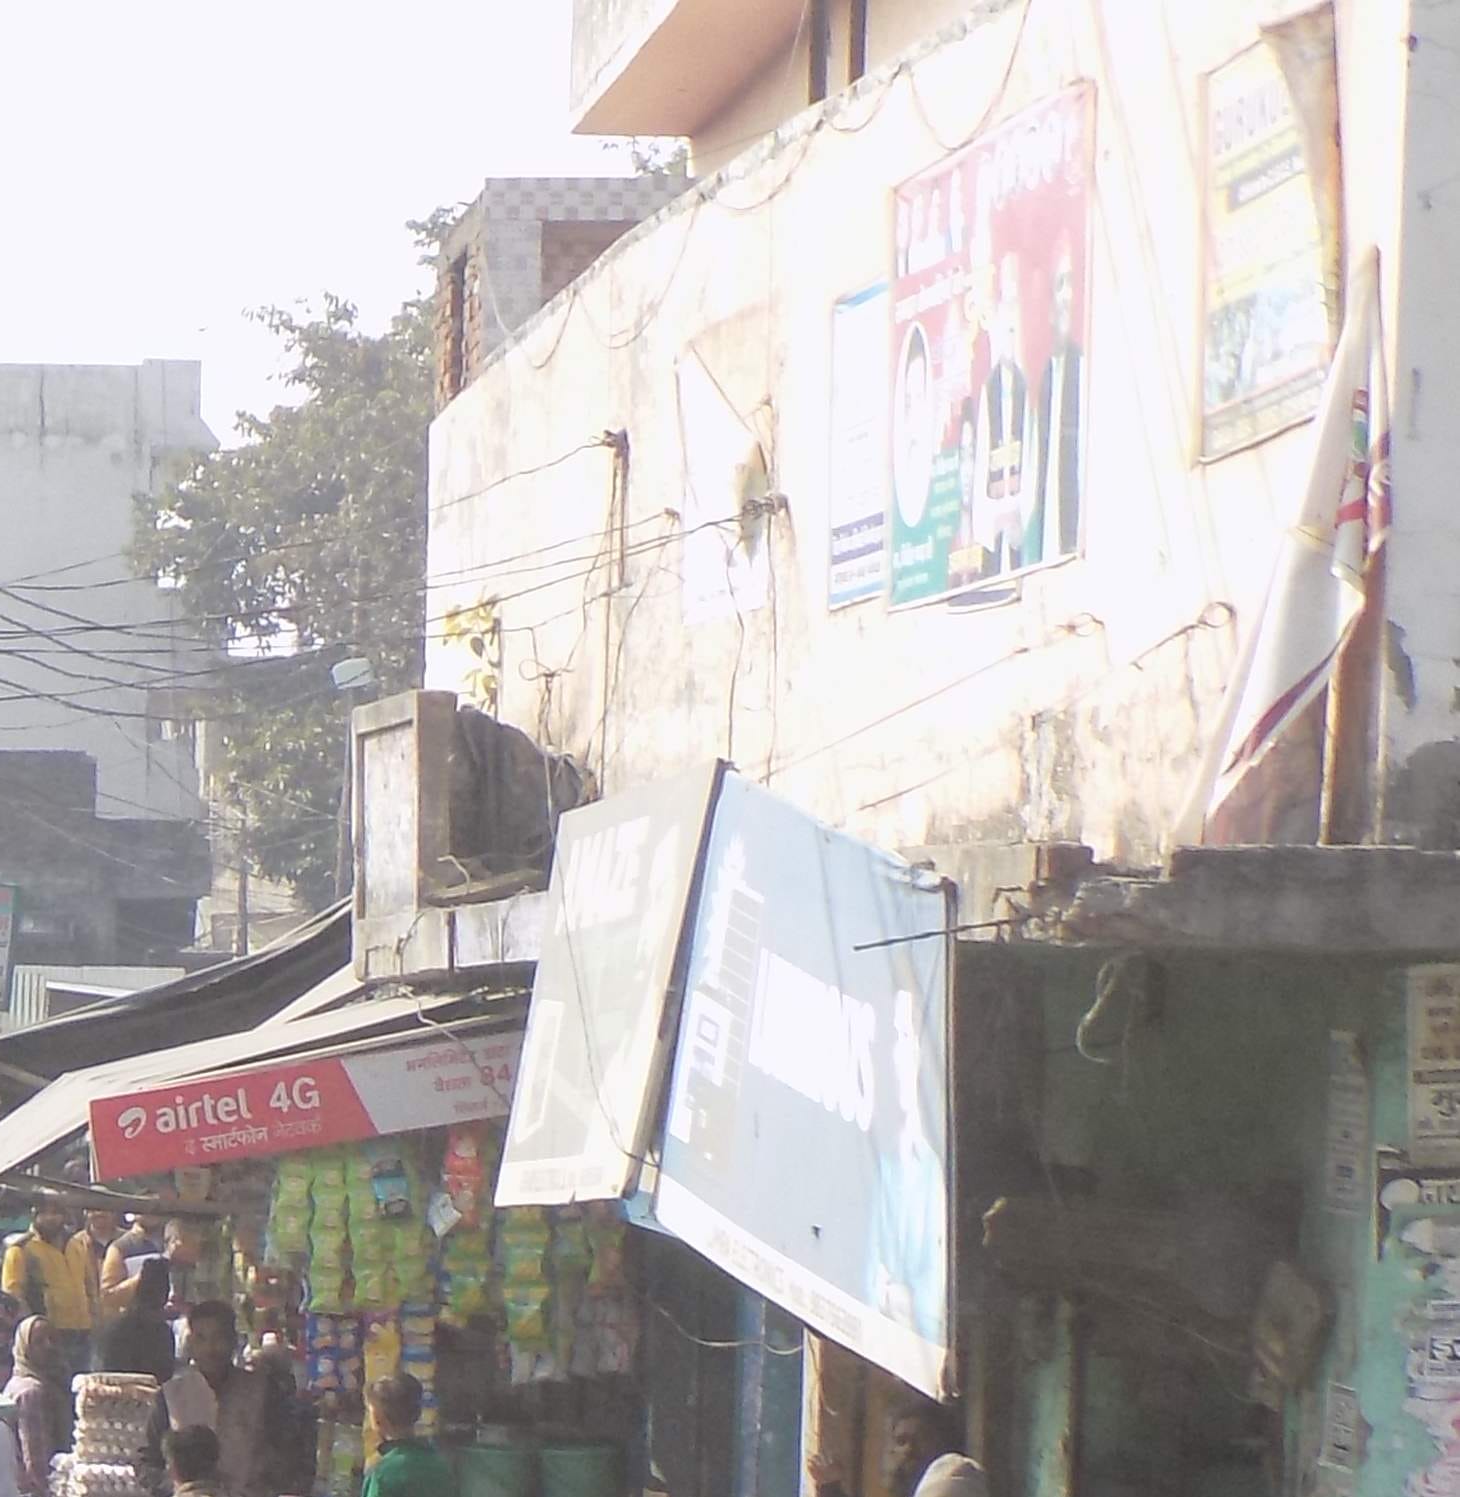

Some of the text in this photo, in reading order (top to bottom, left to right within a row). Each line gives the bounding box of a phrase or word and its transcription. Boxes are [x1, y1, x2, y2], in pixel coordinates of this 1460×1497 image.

[155, 1076, 321, 1134] airtel 4G
[200, 1123, 268, 1153] स्मार्टफोन
